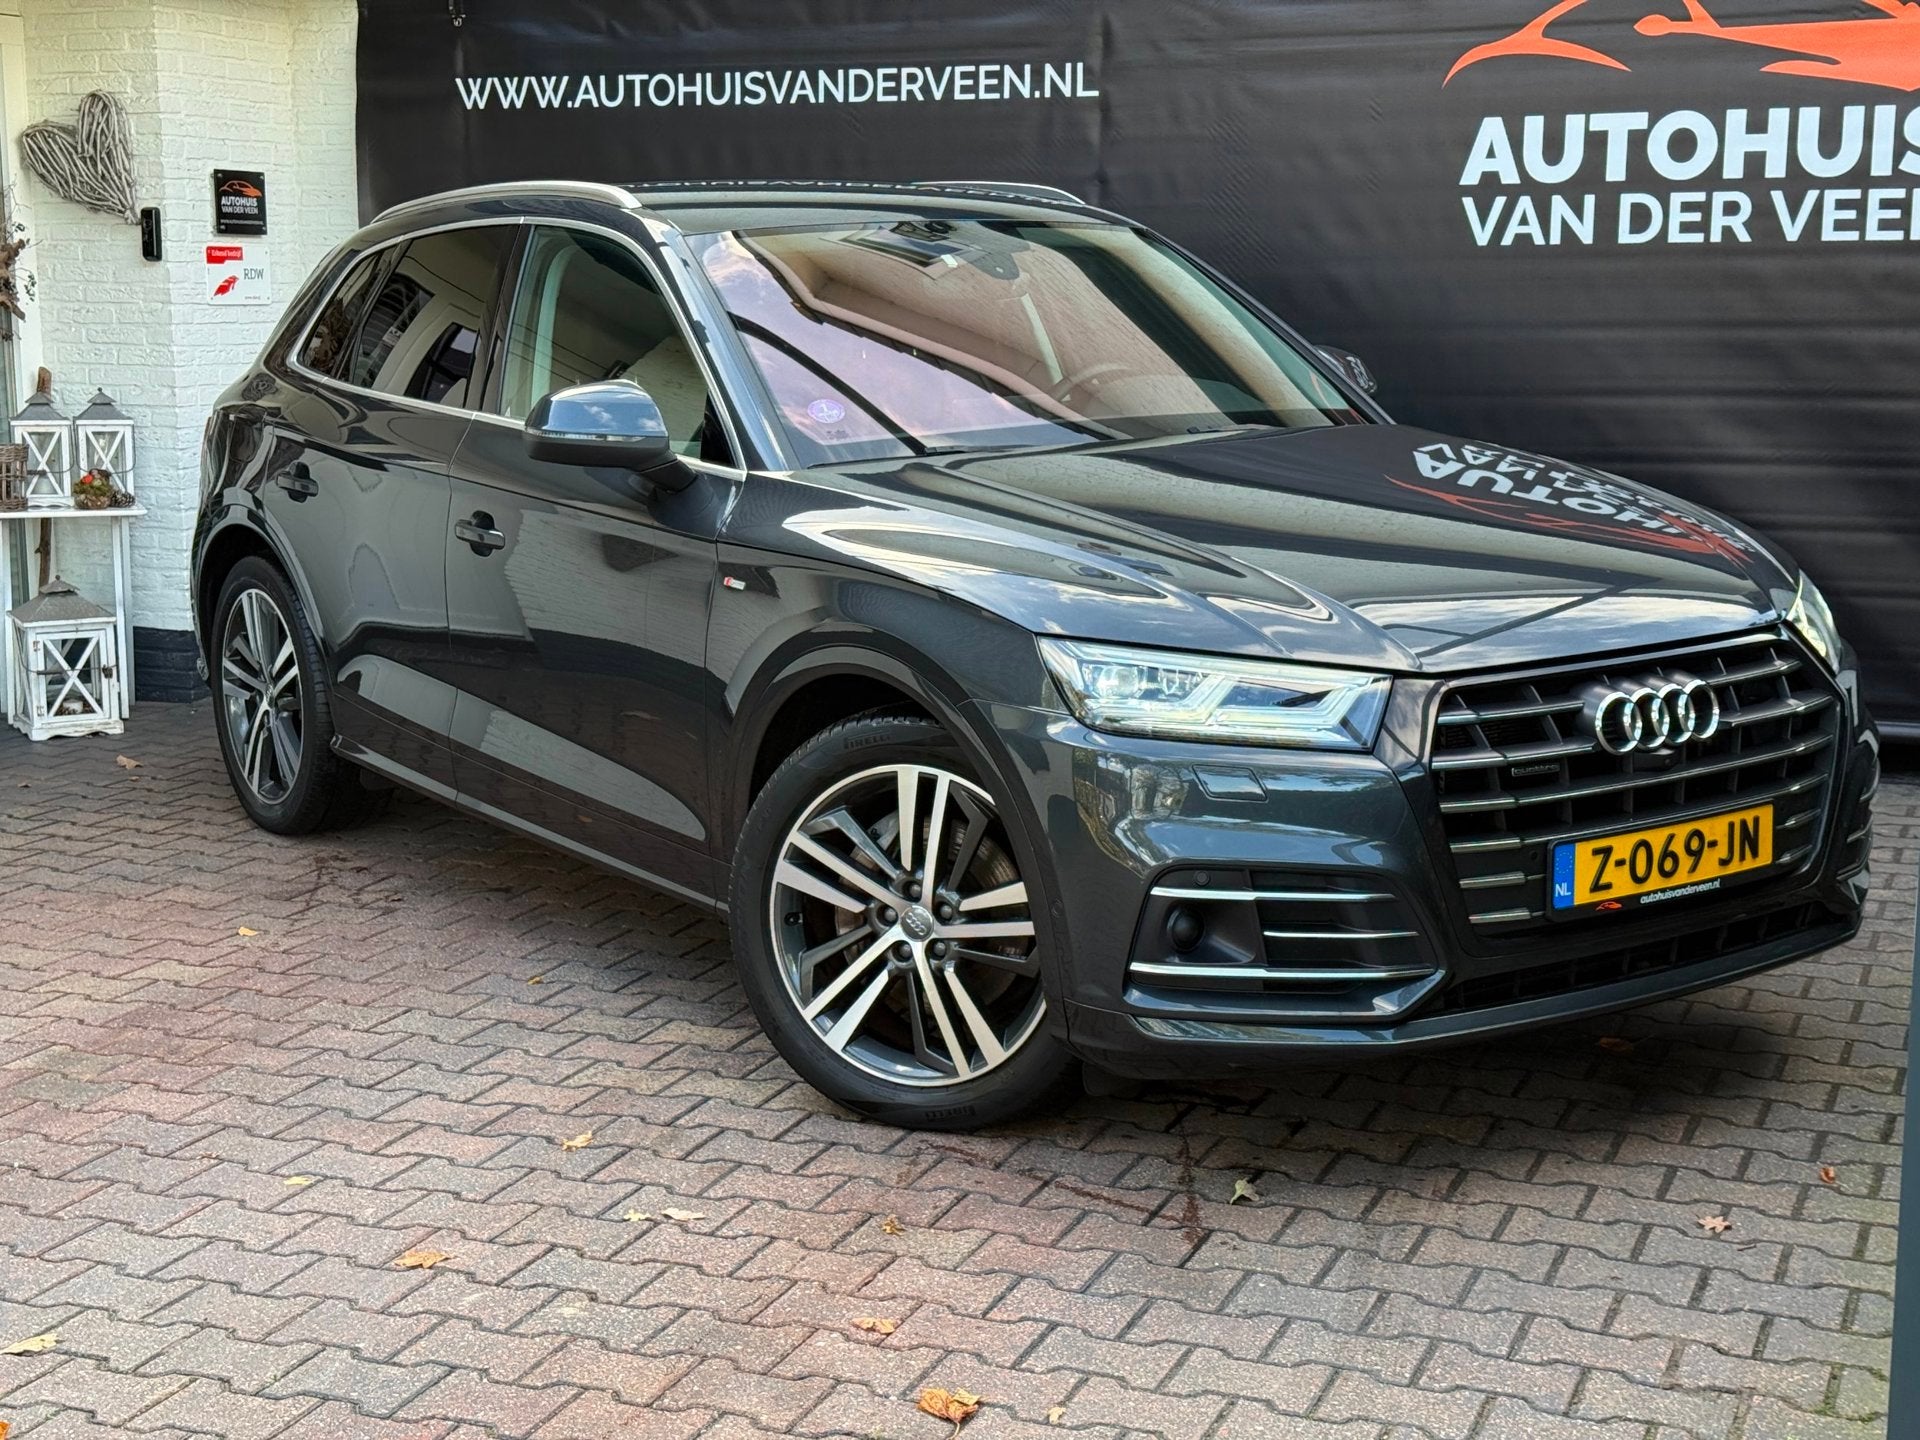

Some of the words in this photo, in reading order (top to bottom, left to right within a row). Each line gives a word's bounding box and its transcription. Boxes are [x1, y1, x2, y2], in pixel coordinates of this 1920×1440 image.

[455, 63, 1100, 110] WWW.AUTOHUISVANDERVEEN.NL
[221, 196, 258, 206] AUTOHUIS
[234, 206, 244, 214] DER
[244, 207, 259, 215] VEEN
[1461, 194, 1596, 246] VAN
[1617, 191, 1753, 245] DER
[1770, 188, 1920, 243] VEE
[243, 268, 264, 281] RDW
[1589, 815, 1761, 894] Z-069-JN
[1555, 882, 1572, 898] NL
[1640, 878, 1721, 904] autohuisvanderveen.nl
